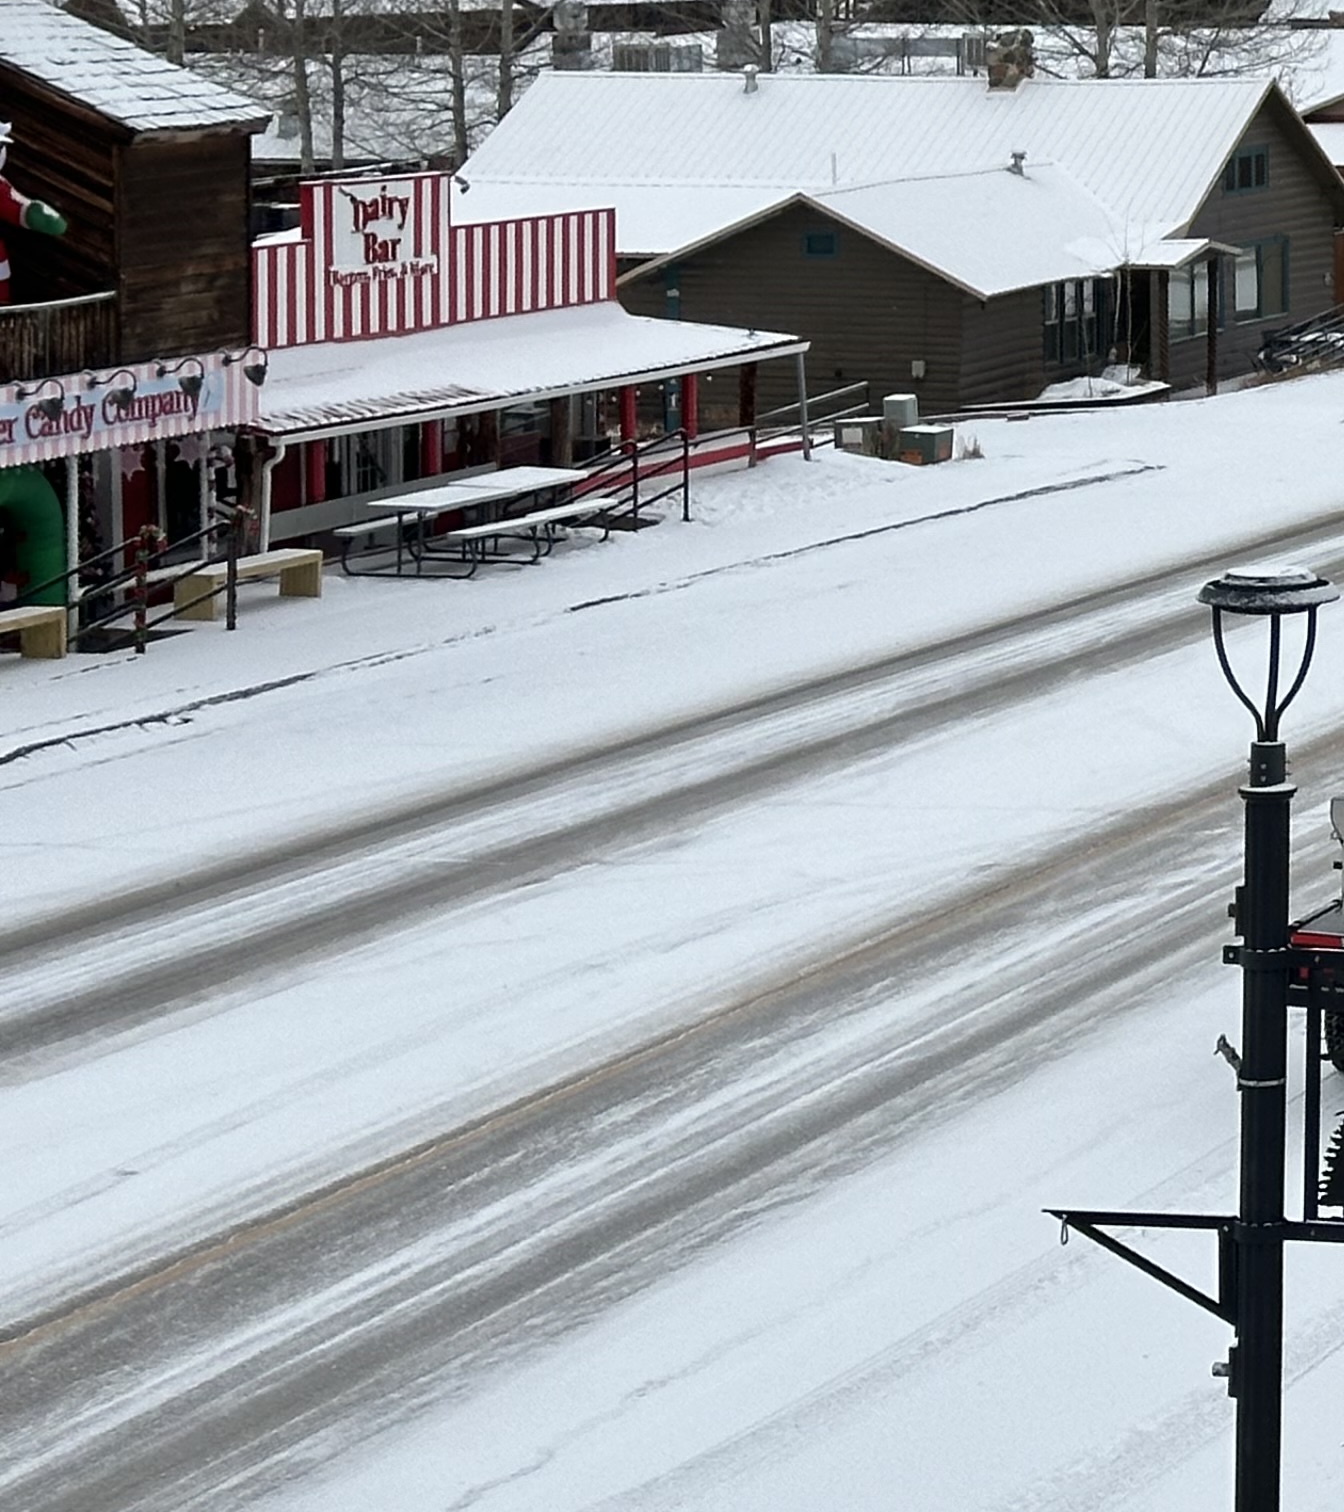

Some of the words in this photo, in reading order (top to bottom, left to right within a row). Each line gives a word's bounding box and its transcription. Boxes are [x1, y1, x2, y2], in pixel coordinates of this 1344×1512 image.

[362, 232, 402, 264] Bar
[25, 396, 96, 439] Candy
[102, 390, 199, 427] Company
